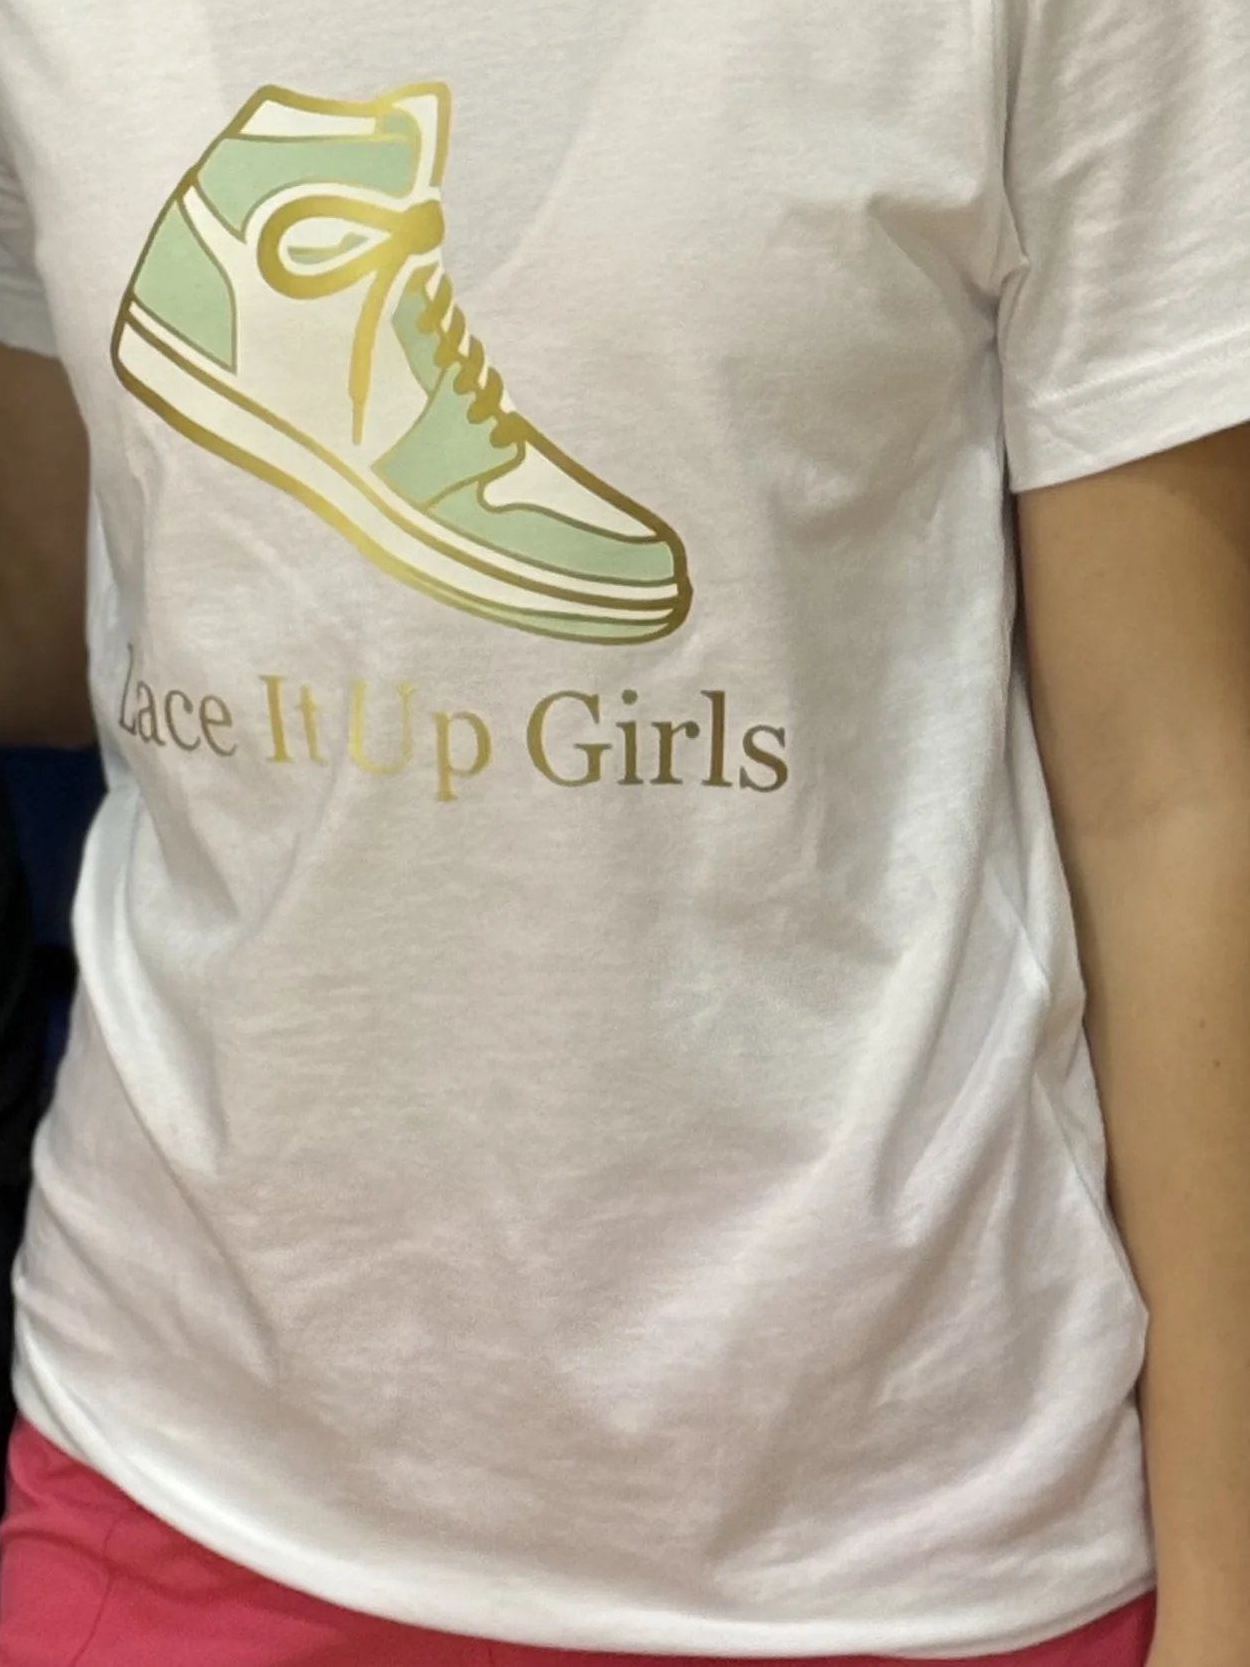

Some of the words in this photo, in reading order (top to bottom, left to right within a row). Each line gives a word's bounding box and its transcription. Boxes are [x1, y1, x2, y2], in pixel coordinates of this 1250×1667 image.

[118, 642, 238, 757] Lace
[258, 673, 327, 768] It
[349, 677, 493, 802] Up
[525, 688, 790, 794] Girls
